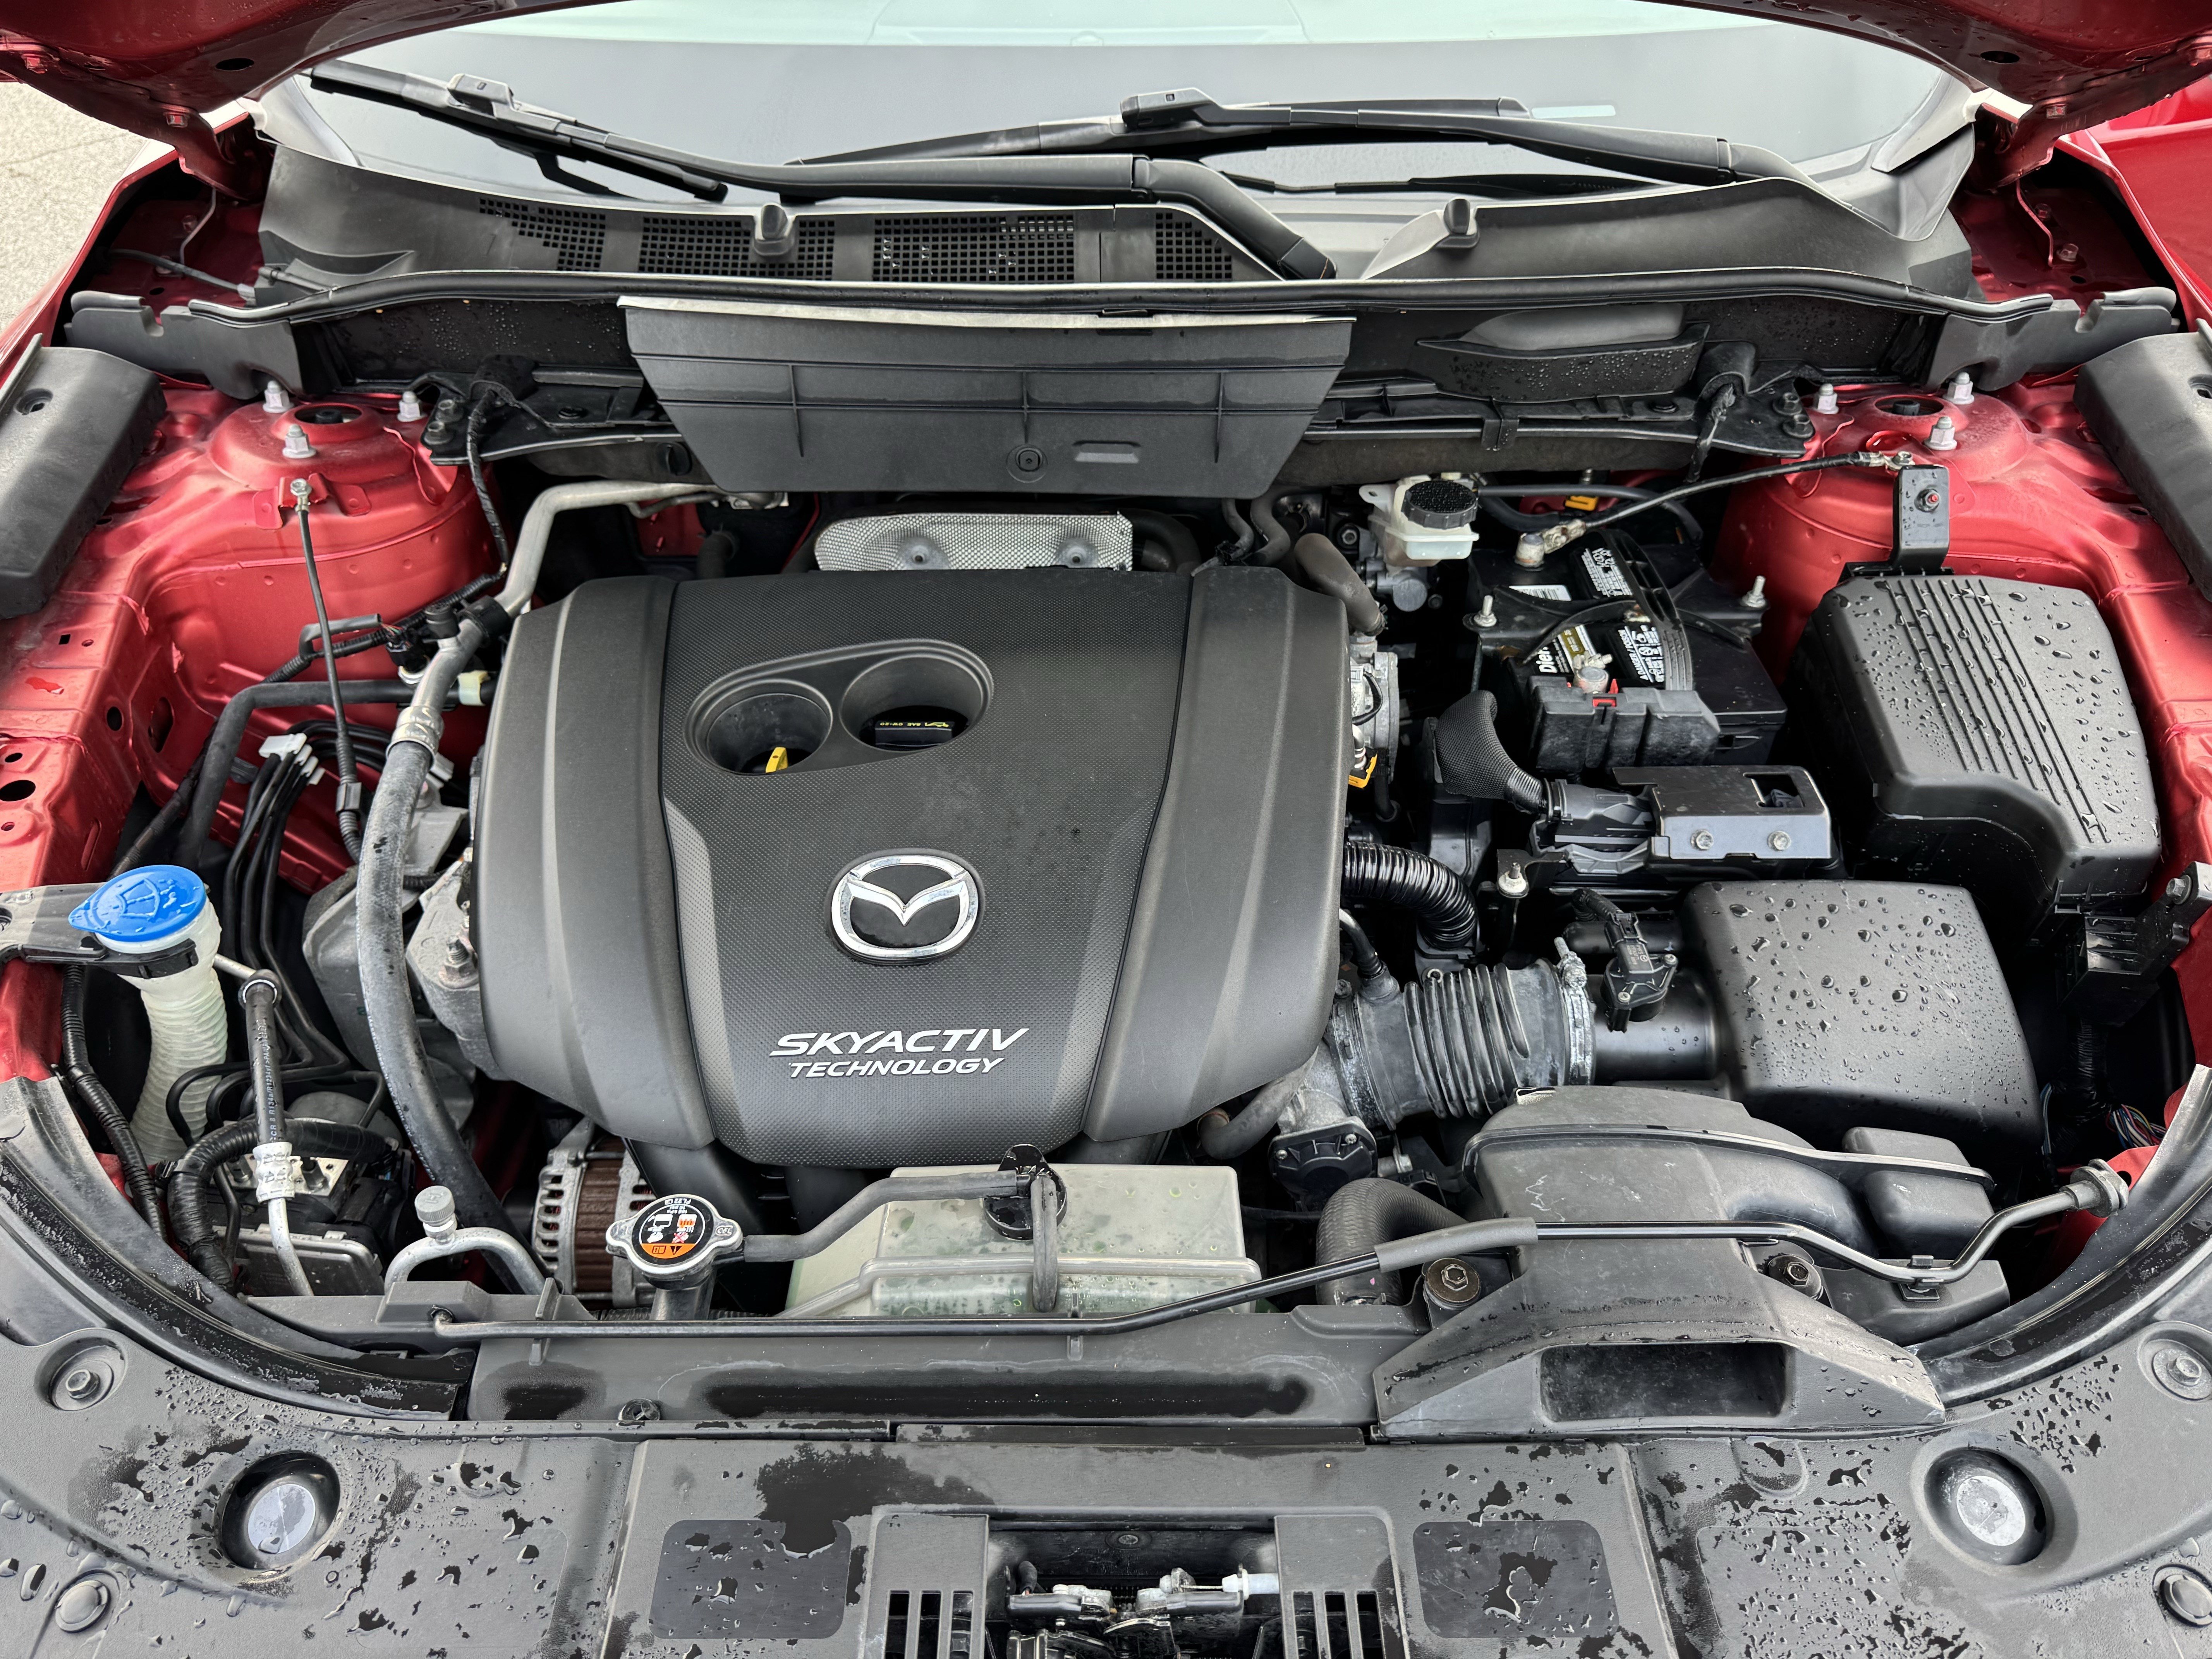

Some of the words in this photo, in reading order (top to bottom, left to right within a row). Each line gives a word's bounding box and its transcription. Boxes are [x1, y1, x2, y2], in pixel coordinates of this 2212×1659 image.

[1629, 653, 1646, 675] DANGER
[769, 1028, 1030, 1056] SKYACTIV
[790, 1058, 1005, 1078] TECHNOLOGY
